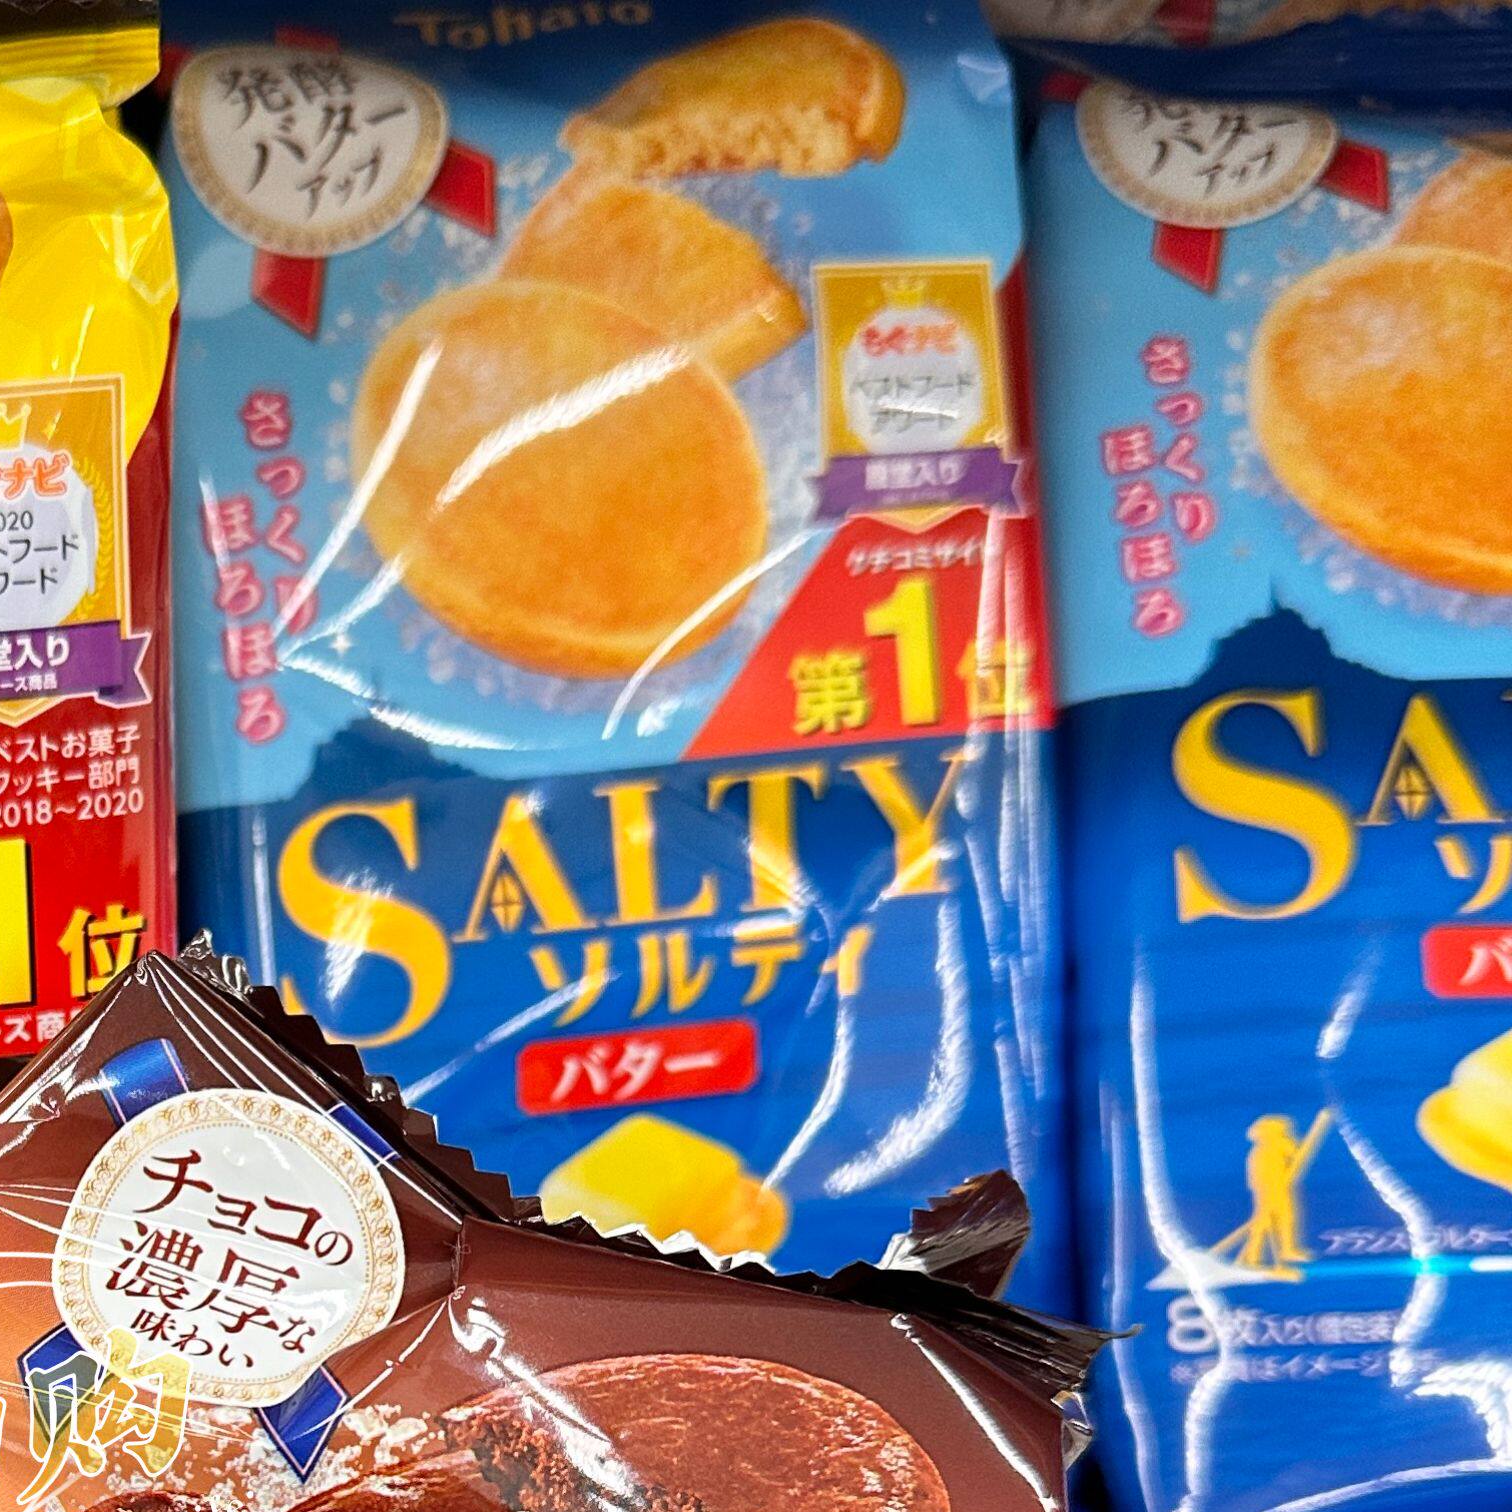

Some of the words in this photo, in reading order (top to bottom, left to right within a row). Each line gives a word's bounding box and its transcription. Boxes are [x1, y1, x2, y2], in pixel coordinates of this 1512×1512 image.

[247, 102, 407, 195] バター
[239, 388, 319, 632] さっくり
[202, 494, 285, 744] ほろほろ
[1171, 687, 1512, 924] SA
[277, 745, 970, 1050] SALTY
[529, 918, 876, 1029] ソルティ
[549, 1036, 720, 1100] バター
[131, 1149, 354, 1267] チョコの
[104, 1219, 317, 1354] 濃厚な
[130, 1307, 255, 1369] 味わい
